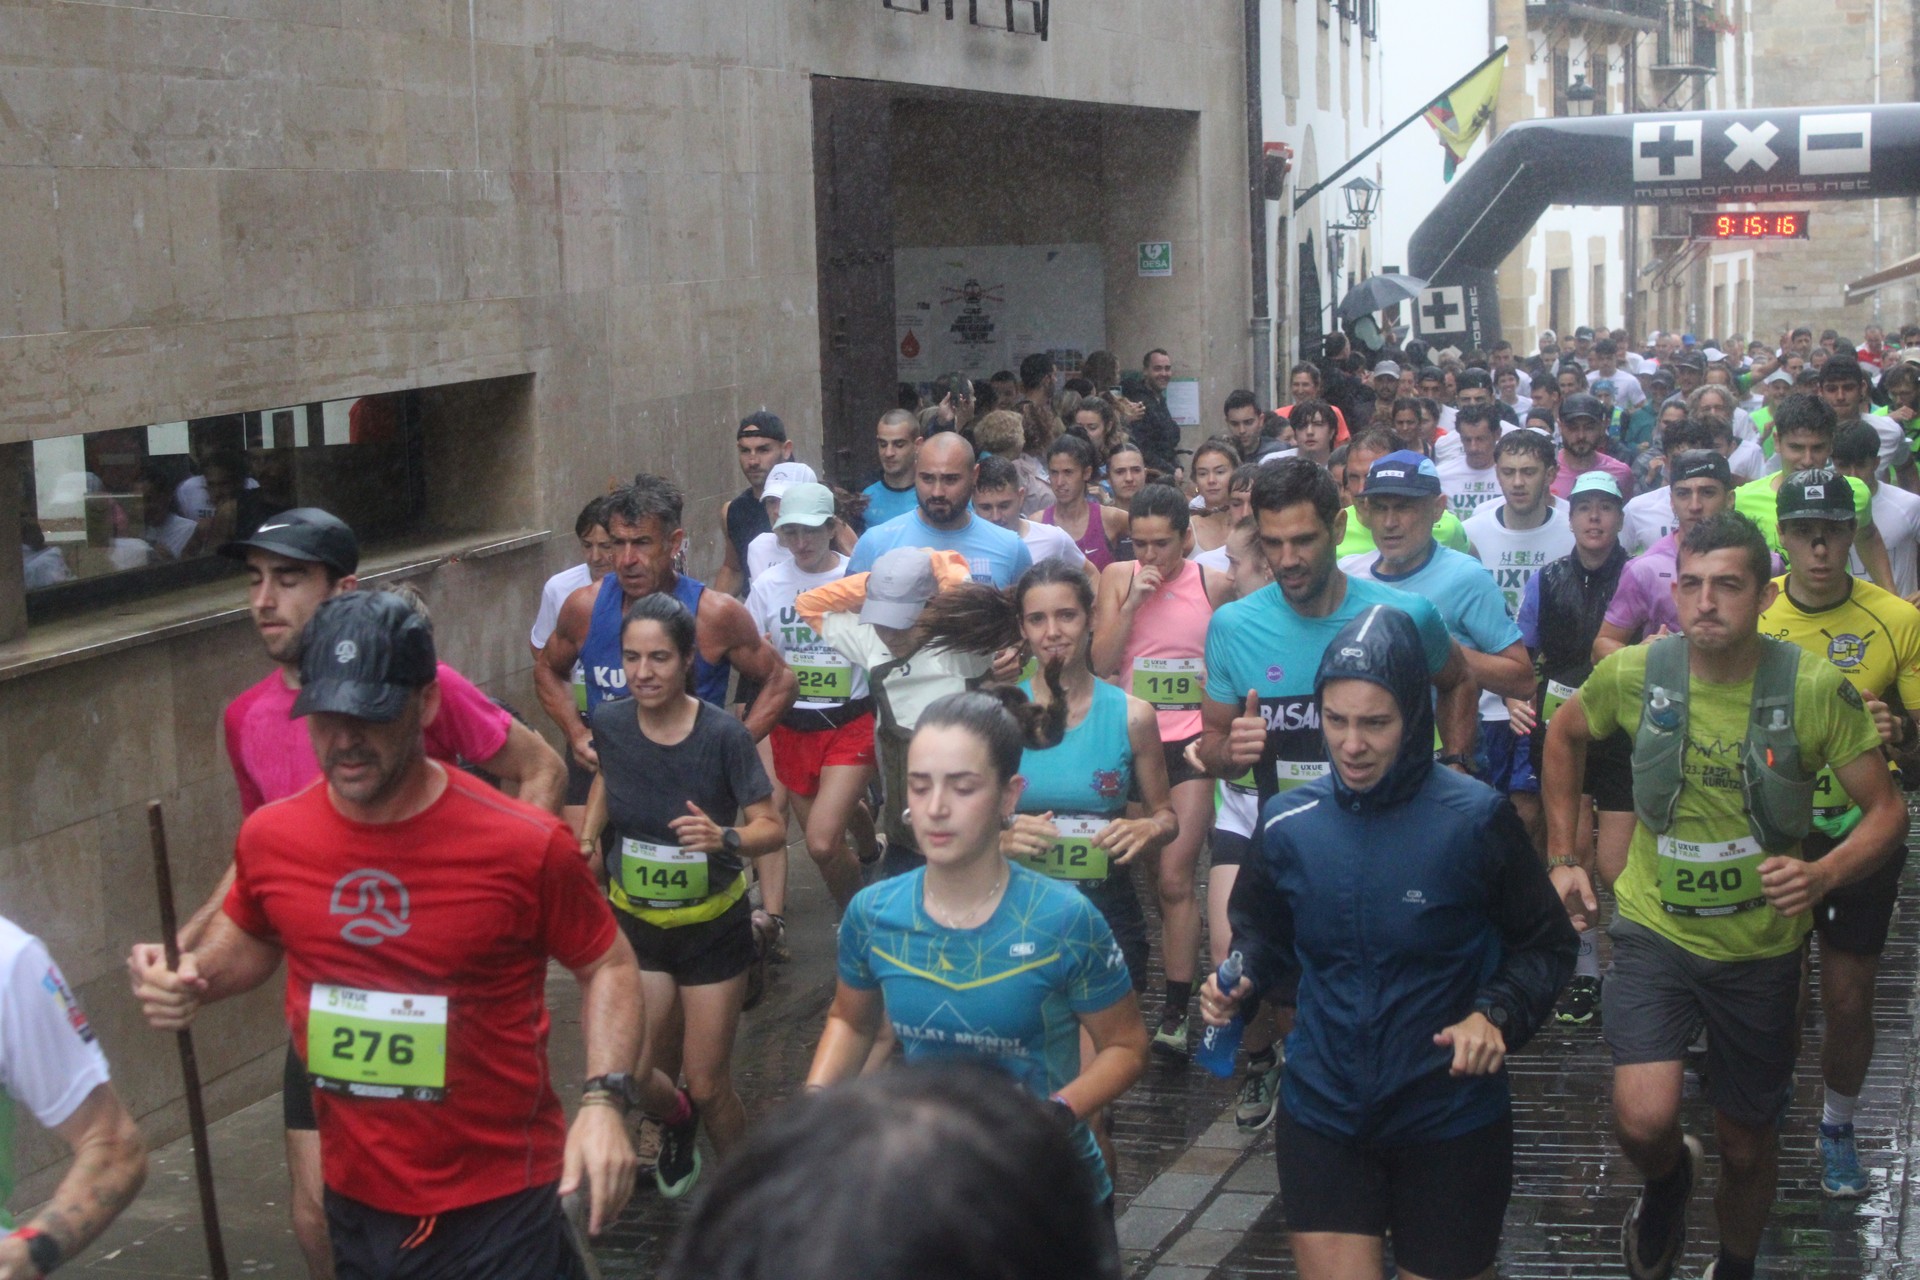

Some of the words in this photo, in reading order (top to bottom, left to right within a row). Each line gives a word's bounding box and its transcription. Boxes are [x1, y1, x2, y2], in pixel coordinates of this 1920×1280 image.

[1634, 179, 1871, 198] maspormenos.net
[1142, 260, 1168, 268] DESA
[797, 671, 837, 688] 224
[1147, 677, 1190, 694] 119
[1290, 764, 1299, 776] 5
[1702, 766, 1731, 778] ZAZPI
[1702, 777, 1741, 790] KURUTZ
[1813, 774, 1832, 795] 4
[630, 842, 639, 853] 5
[1678, 842, 1700, 852] UXUE
[635, 866, 689, 889] 144
[1676, 867, 1742, 893] 240
[328, 987, 339, 1007] 5
[341, 990, 368, 1002] UXUE
[332, 1026, 415, 1066] 276
[955, 1031, 1022, 1048] MENDI
